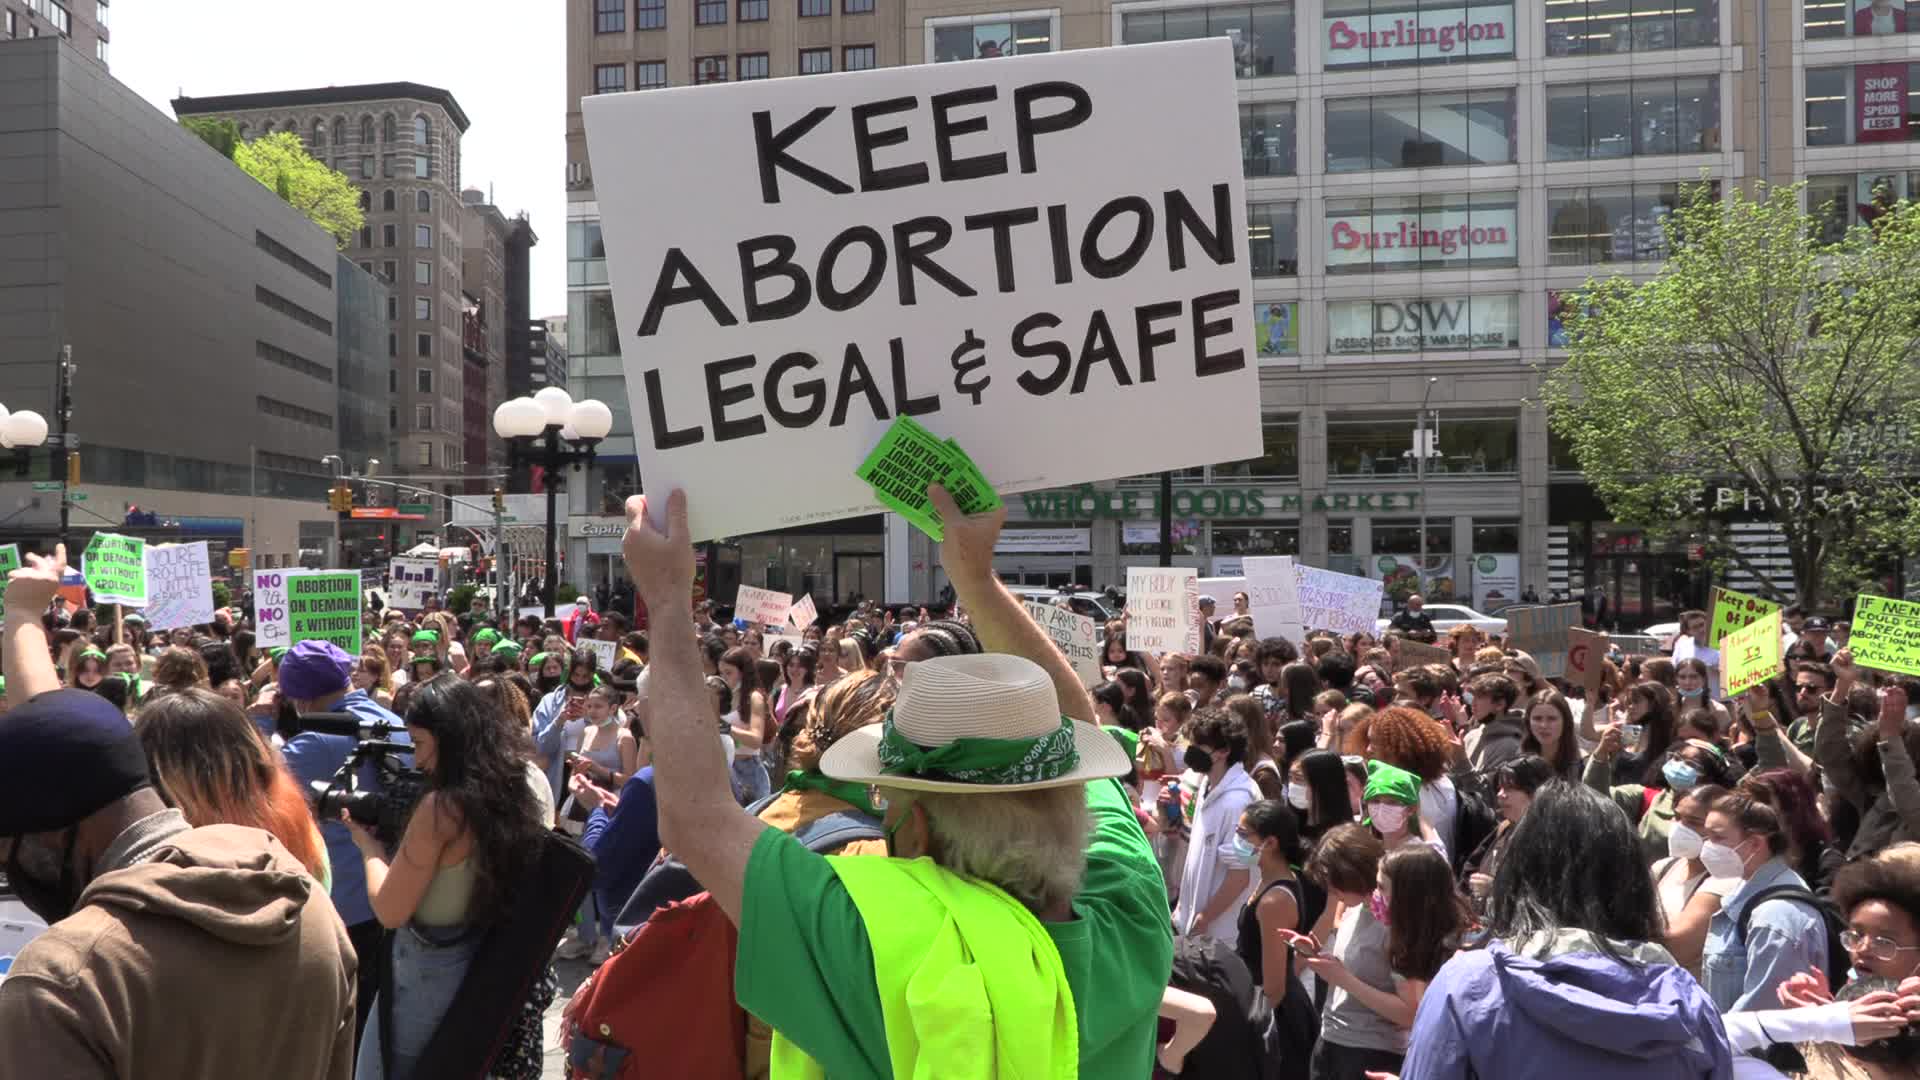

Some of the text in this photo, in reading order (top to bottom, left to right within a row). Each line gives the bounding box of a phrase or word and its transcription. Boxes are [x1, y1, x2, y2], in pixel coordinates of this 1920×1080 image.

[1329, 19, 1505, 52] Burlington
[1864, 77, 1898, 90] SHOP
[1864, 91, 1899, 103] MORE
[1864, 104, 1899, 116] SPEND
[1869, 118, 1894, 128] LESS
[752, 81, 1092, 204] KEEP
[1331, 221, 1507, 255] Burlington
[636, 183, 1235, 337] ABORTION
[1375, 300, 1466, 333] DSW
[1335, 332, 1504, 349] DESIGNER SHOE WAREHOUSE
[643, 336, 941, 450] LEGAL
[951, 328, 991, 405] &
[1011, 289, 1246, 396] SAFE
[893, 432, 953, 477] APOLOGY!
[885, 446, 935, 482] WITHOUT
[876, 458, 919, 490] DEMAND
[867, 468, 928, 511] ABORTION
[1023, 486, 1141, 519] WHOLE
[1282, 492, 1420, 512] MARKET
[103, 552, 142, 567] DEMAND
[100, 566, 139, 580] WITHOUT
[257, 573, 281, 589] NO
[95, 579, 135, 592] APOLOGY
[296, 578, 353, 594] ABORTION
[1130, 575, 1176, 592] MY BODY
[290, 597, 358, 613] ON DEMAND
[1718, 590, 1768, 615] Keep Out
[1862, 598, 1920, 617] IF MEN
[259, 607, 283, 623] NO
[1050, 609, 1077, 631] ARMS
[1726, 611, 1741, 624] Of
[1856, 610, 1900, 626] COULD
[296, 616, 356, 633] & WITHOUT
[1851, 630, 1906, 645] ABORTION
[1070, 643, 1093, 660] THIS
[1895, 645, 1906, 653] A
[1729, 664, 1777, 690] Healthcare
